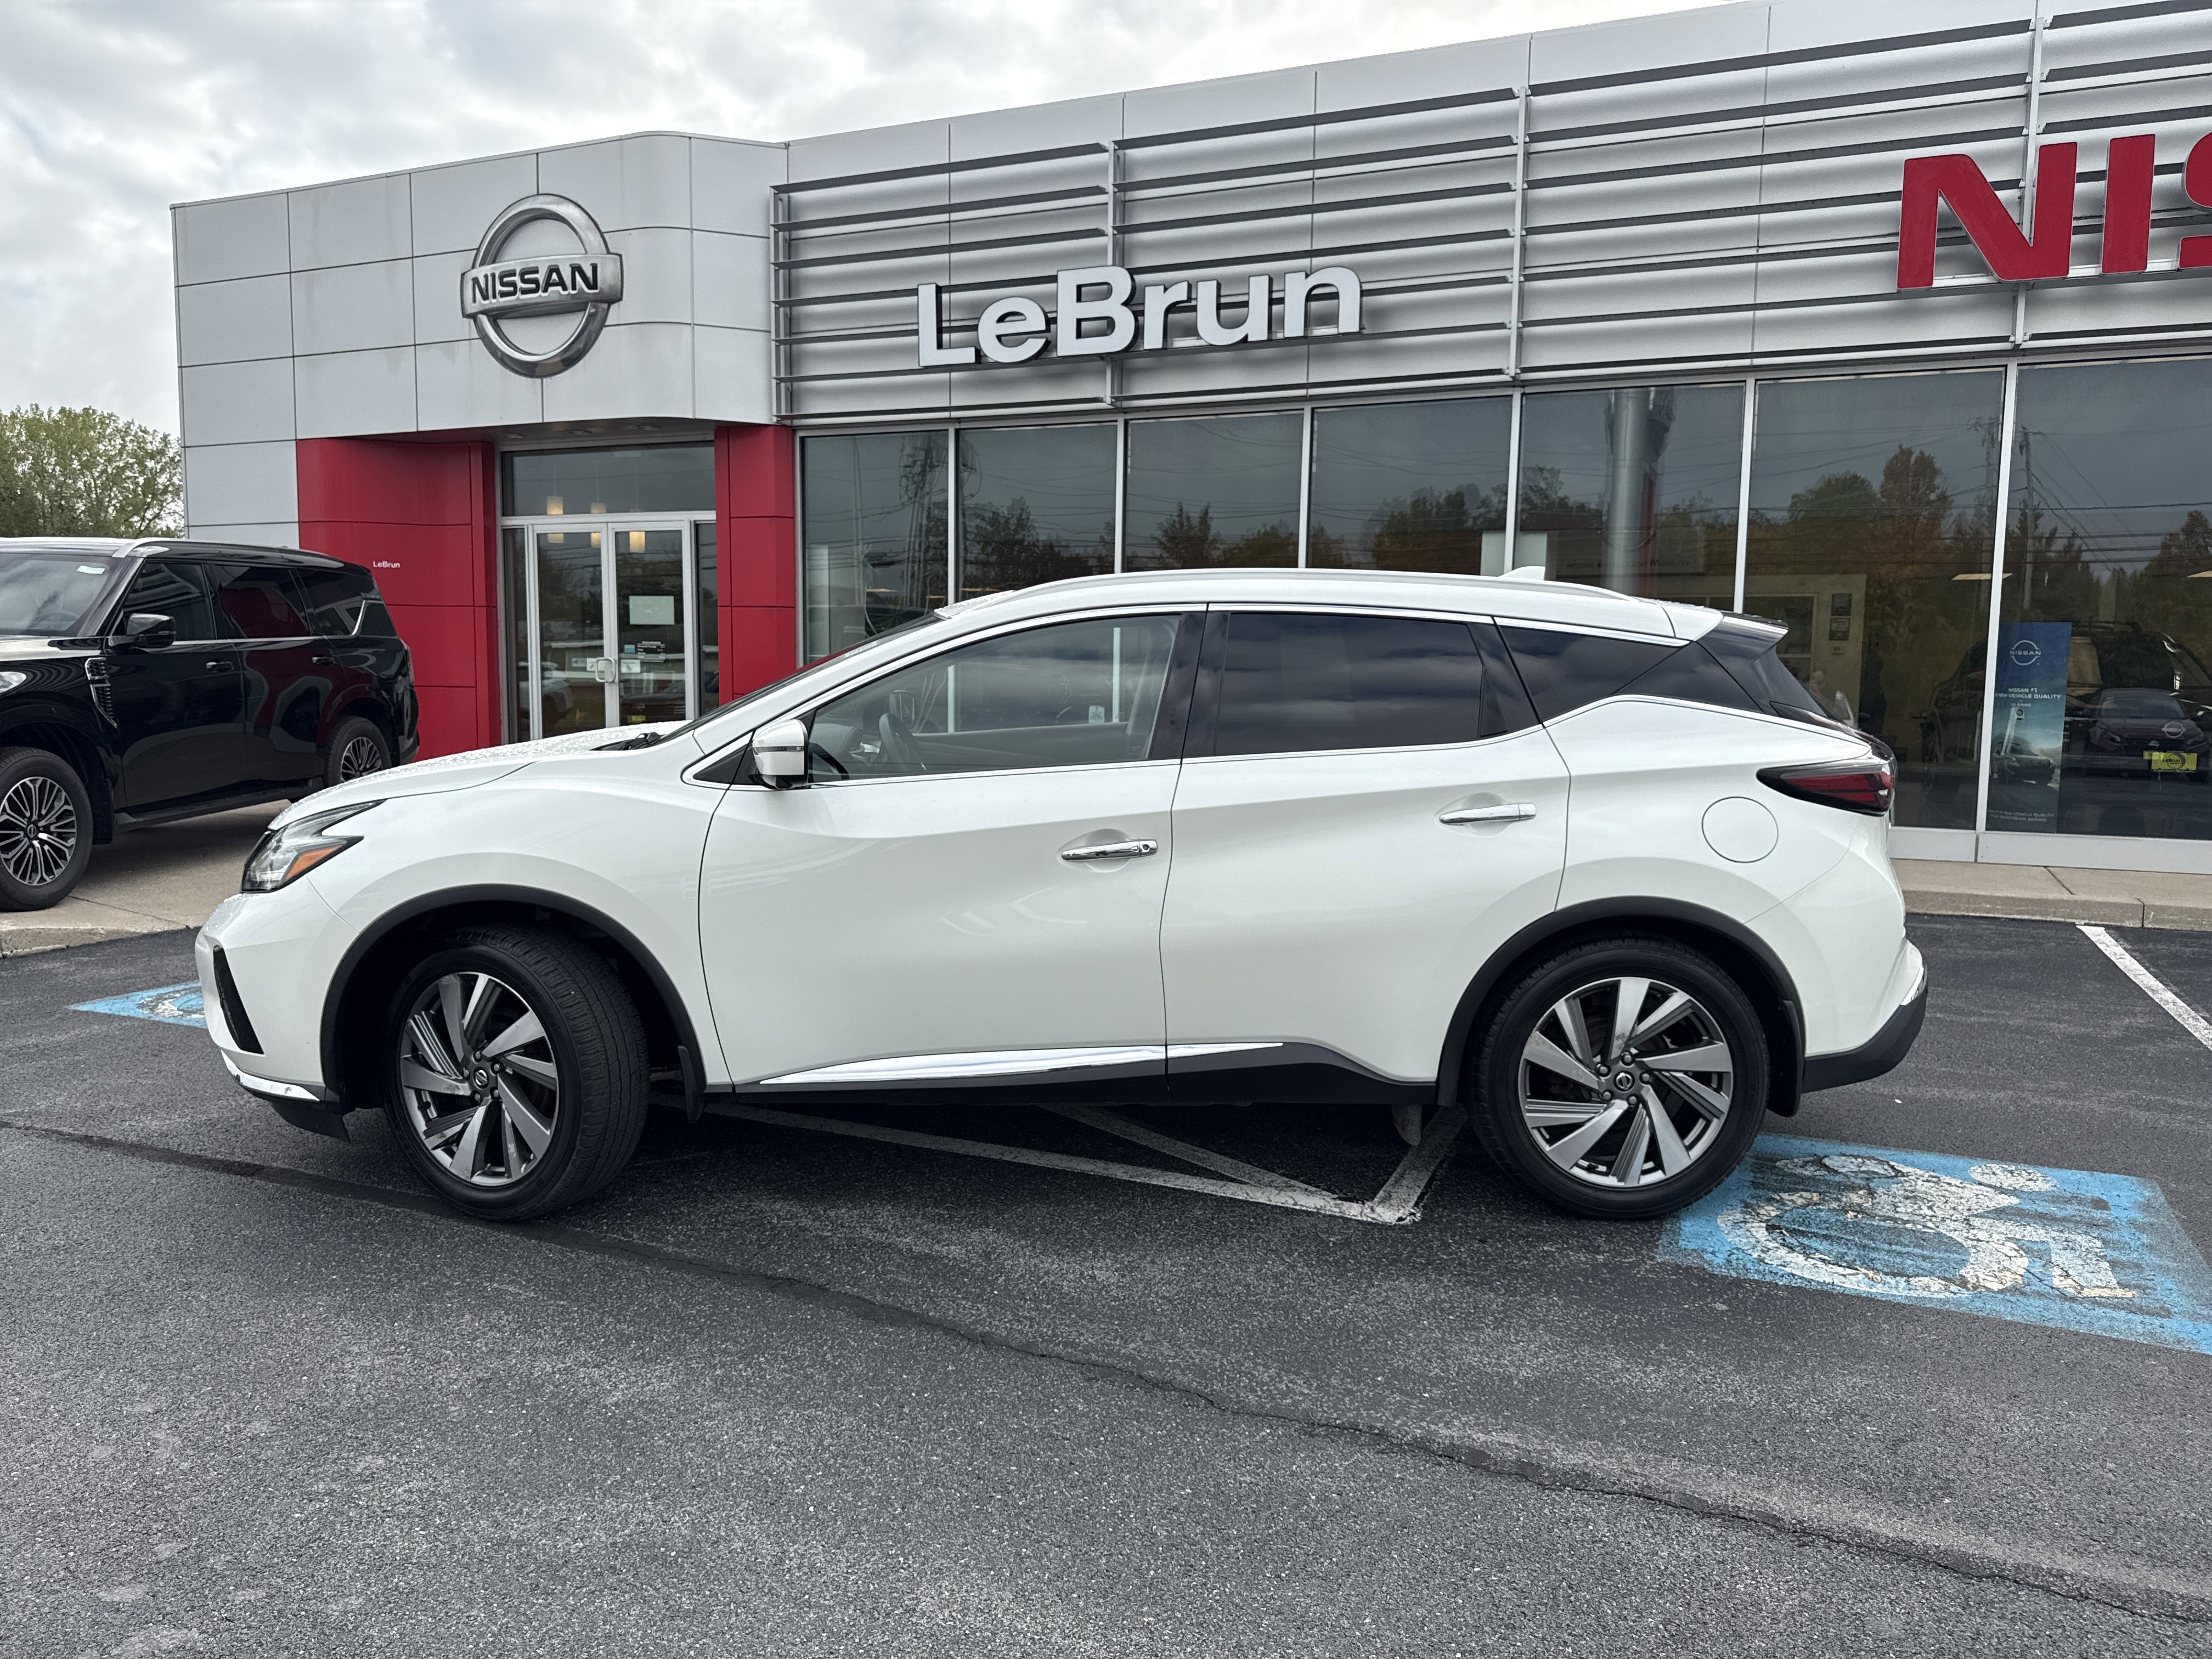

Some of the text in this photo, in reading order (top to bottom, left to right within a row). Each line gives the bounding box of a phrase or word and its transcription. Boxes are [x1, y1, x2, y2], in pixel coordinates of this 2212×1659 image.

[471, 263, 599, 304] NISSAN
[917, 266, 1363, 368] LeBrun
[373, 560, 400, 568] LeBrun
